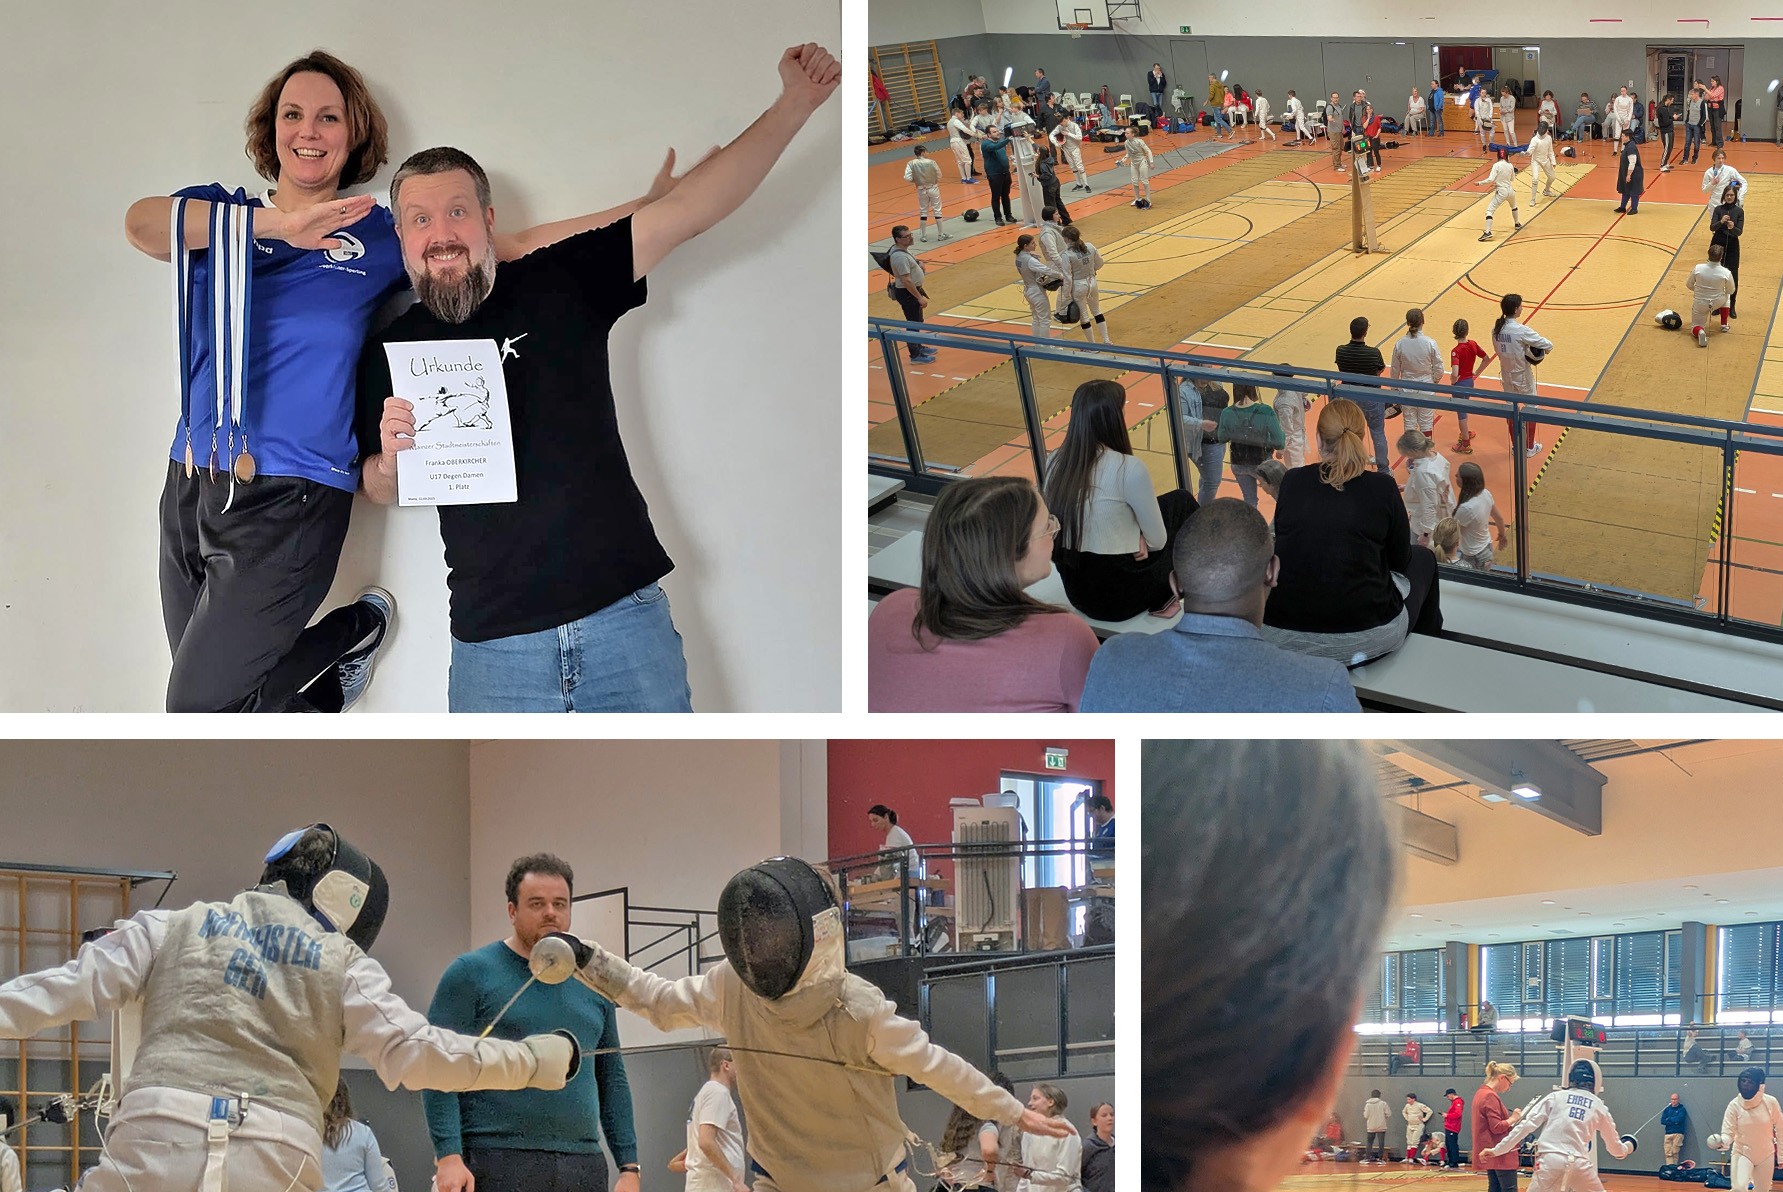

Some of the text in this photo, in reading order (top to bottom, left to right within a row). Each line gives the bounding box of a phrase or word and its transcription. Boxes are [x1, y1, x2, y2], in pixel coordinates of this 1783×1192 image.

[410, 356, 483, 377] Urkunde
[224, 948, 268, 1000] GER
[1567, 1095, 1593, 1109] EHRET
[1569, 1107, 1586, 1121] GER
